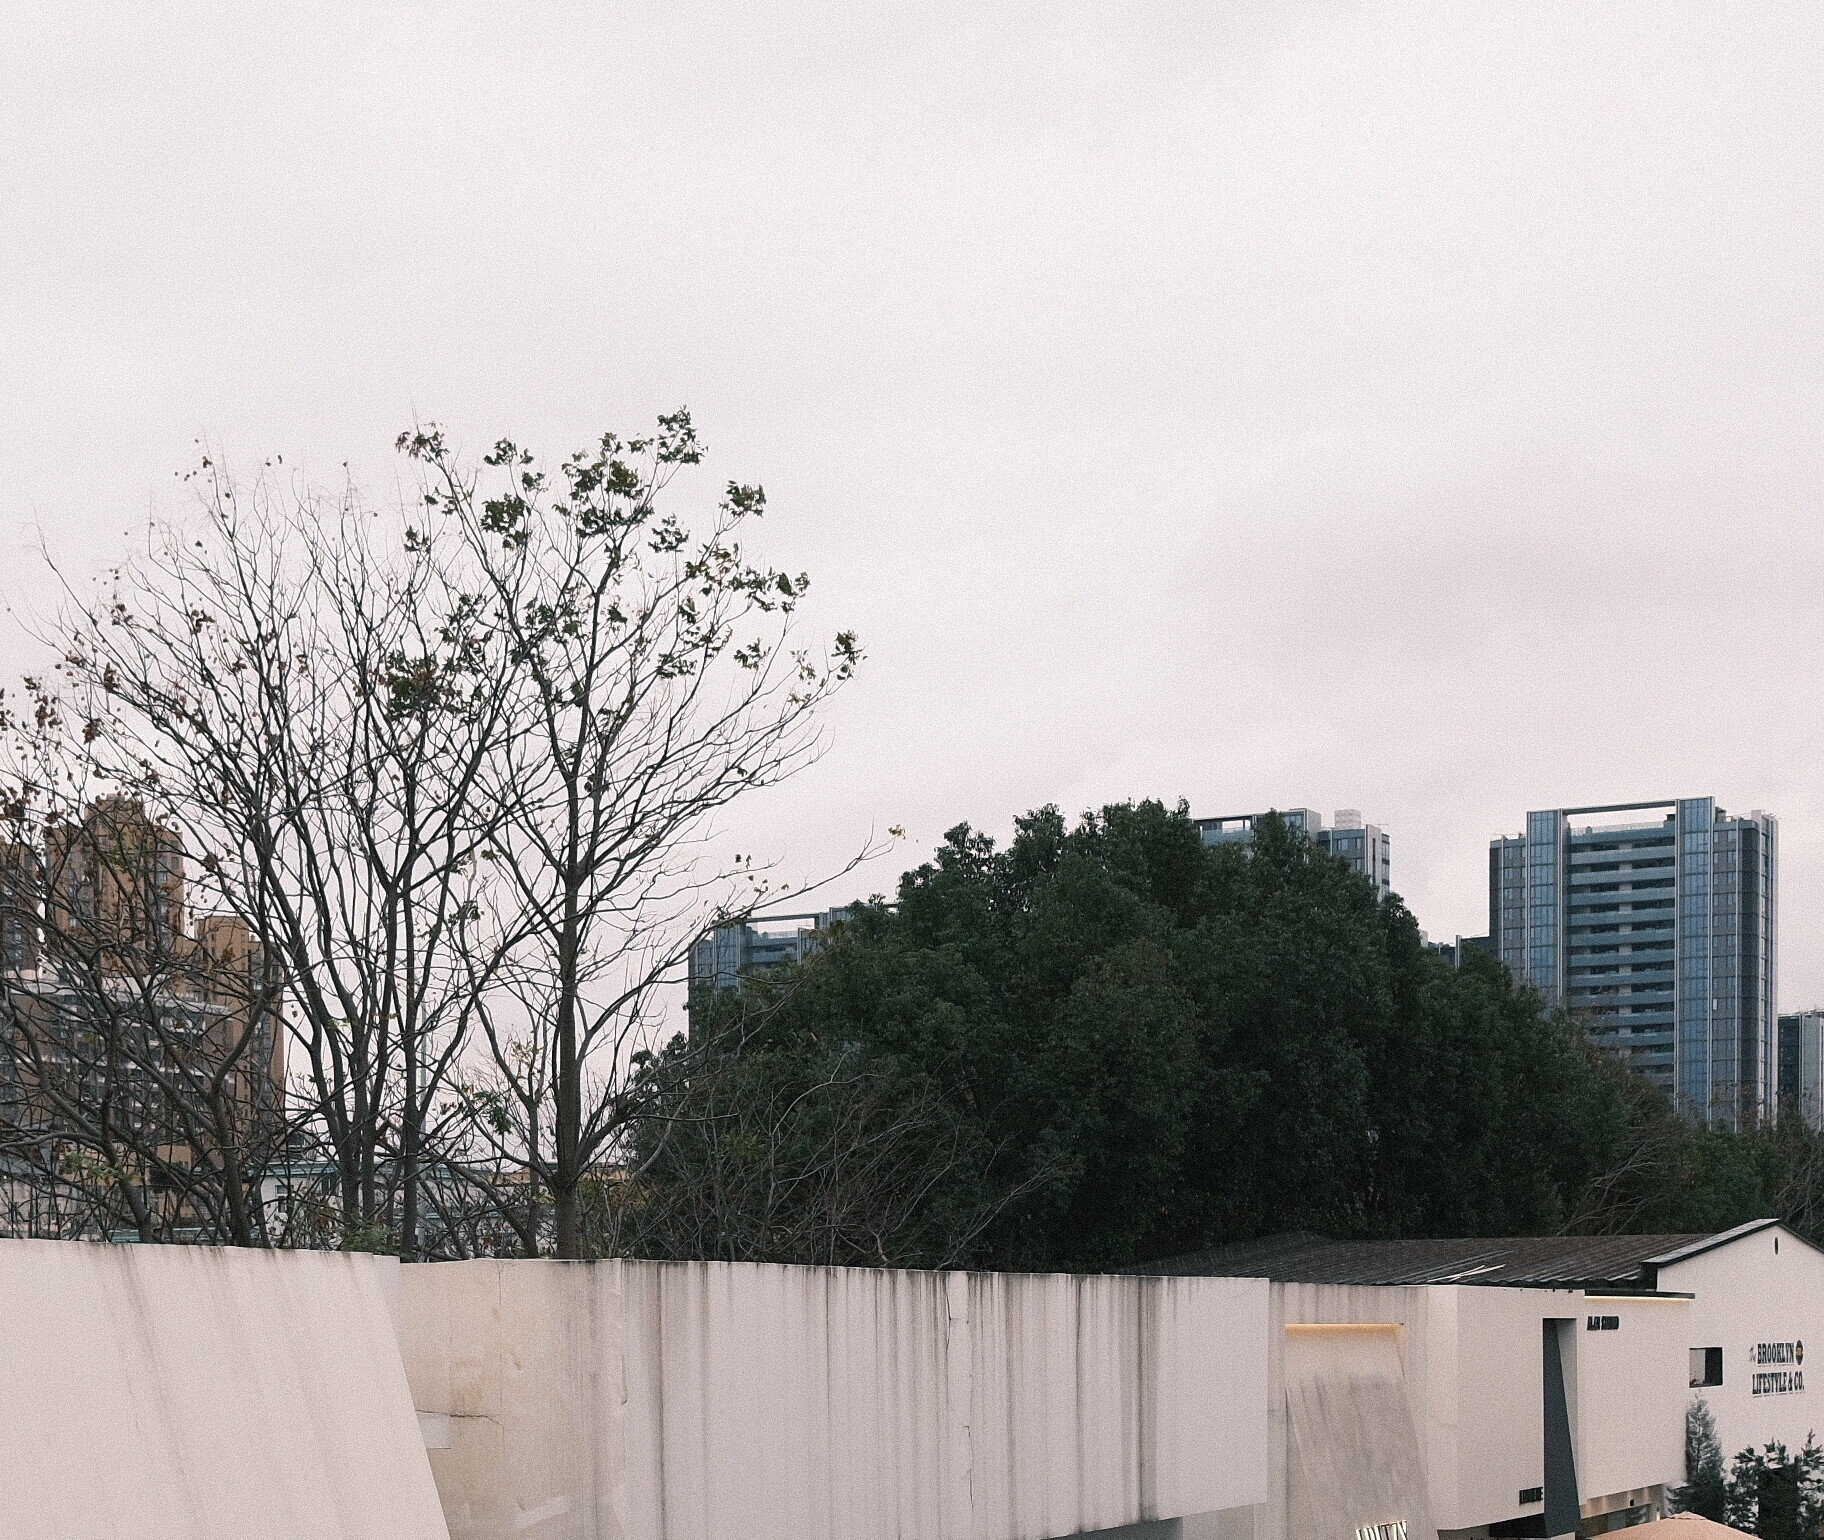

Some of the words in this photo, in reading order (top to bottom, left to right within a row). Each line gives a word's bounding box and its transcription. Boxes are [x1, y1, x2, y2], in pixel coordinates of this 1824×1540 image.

[1757, 1343, 1794, 1364] BROOKLYN
[1752, 1372, 1787, 1395] LIFESTYLE
[1788, 1372, 1793, 1392] &
